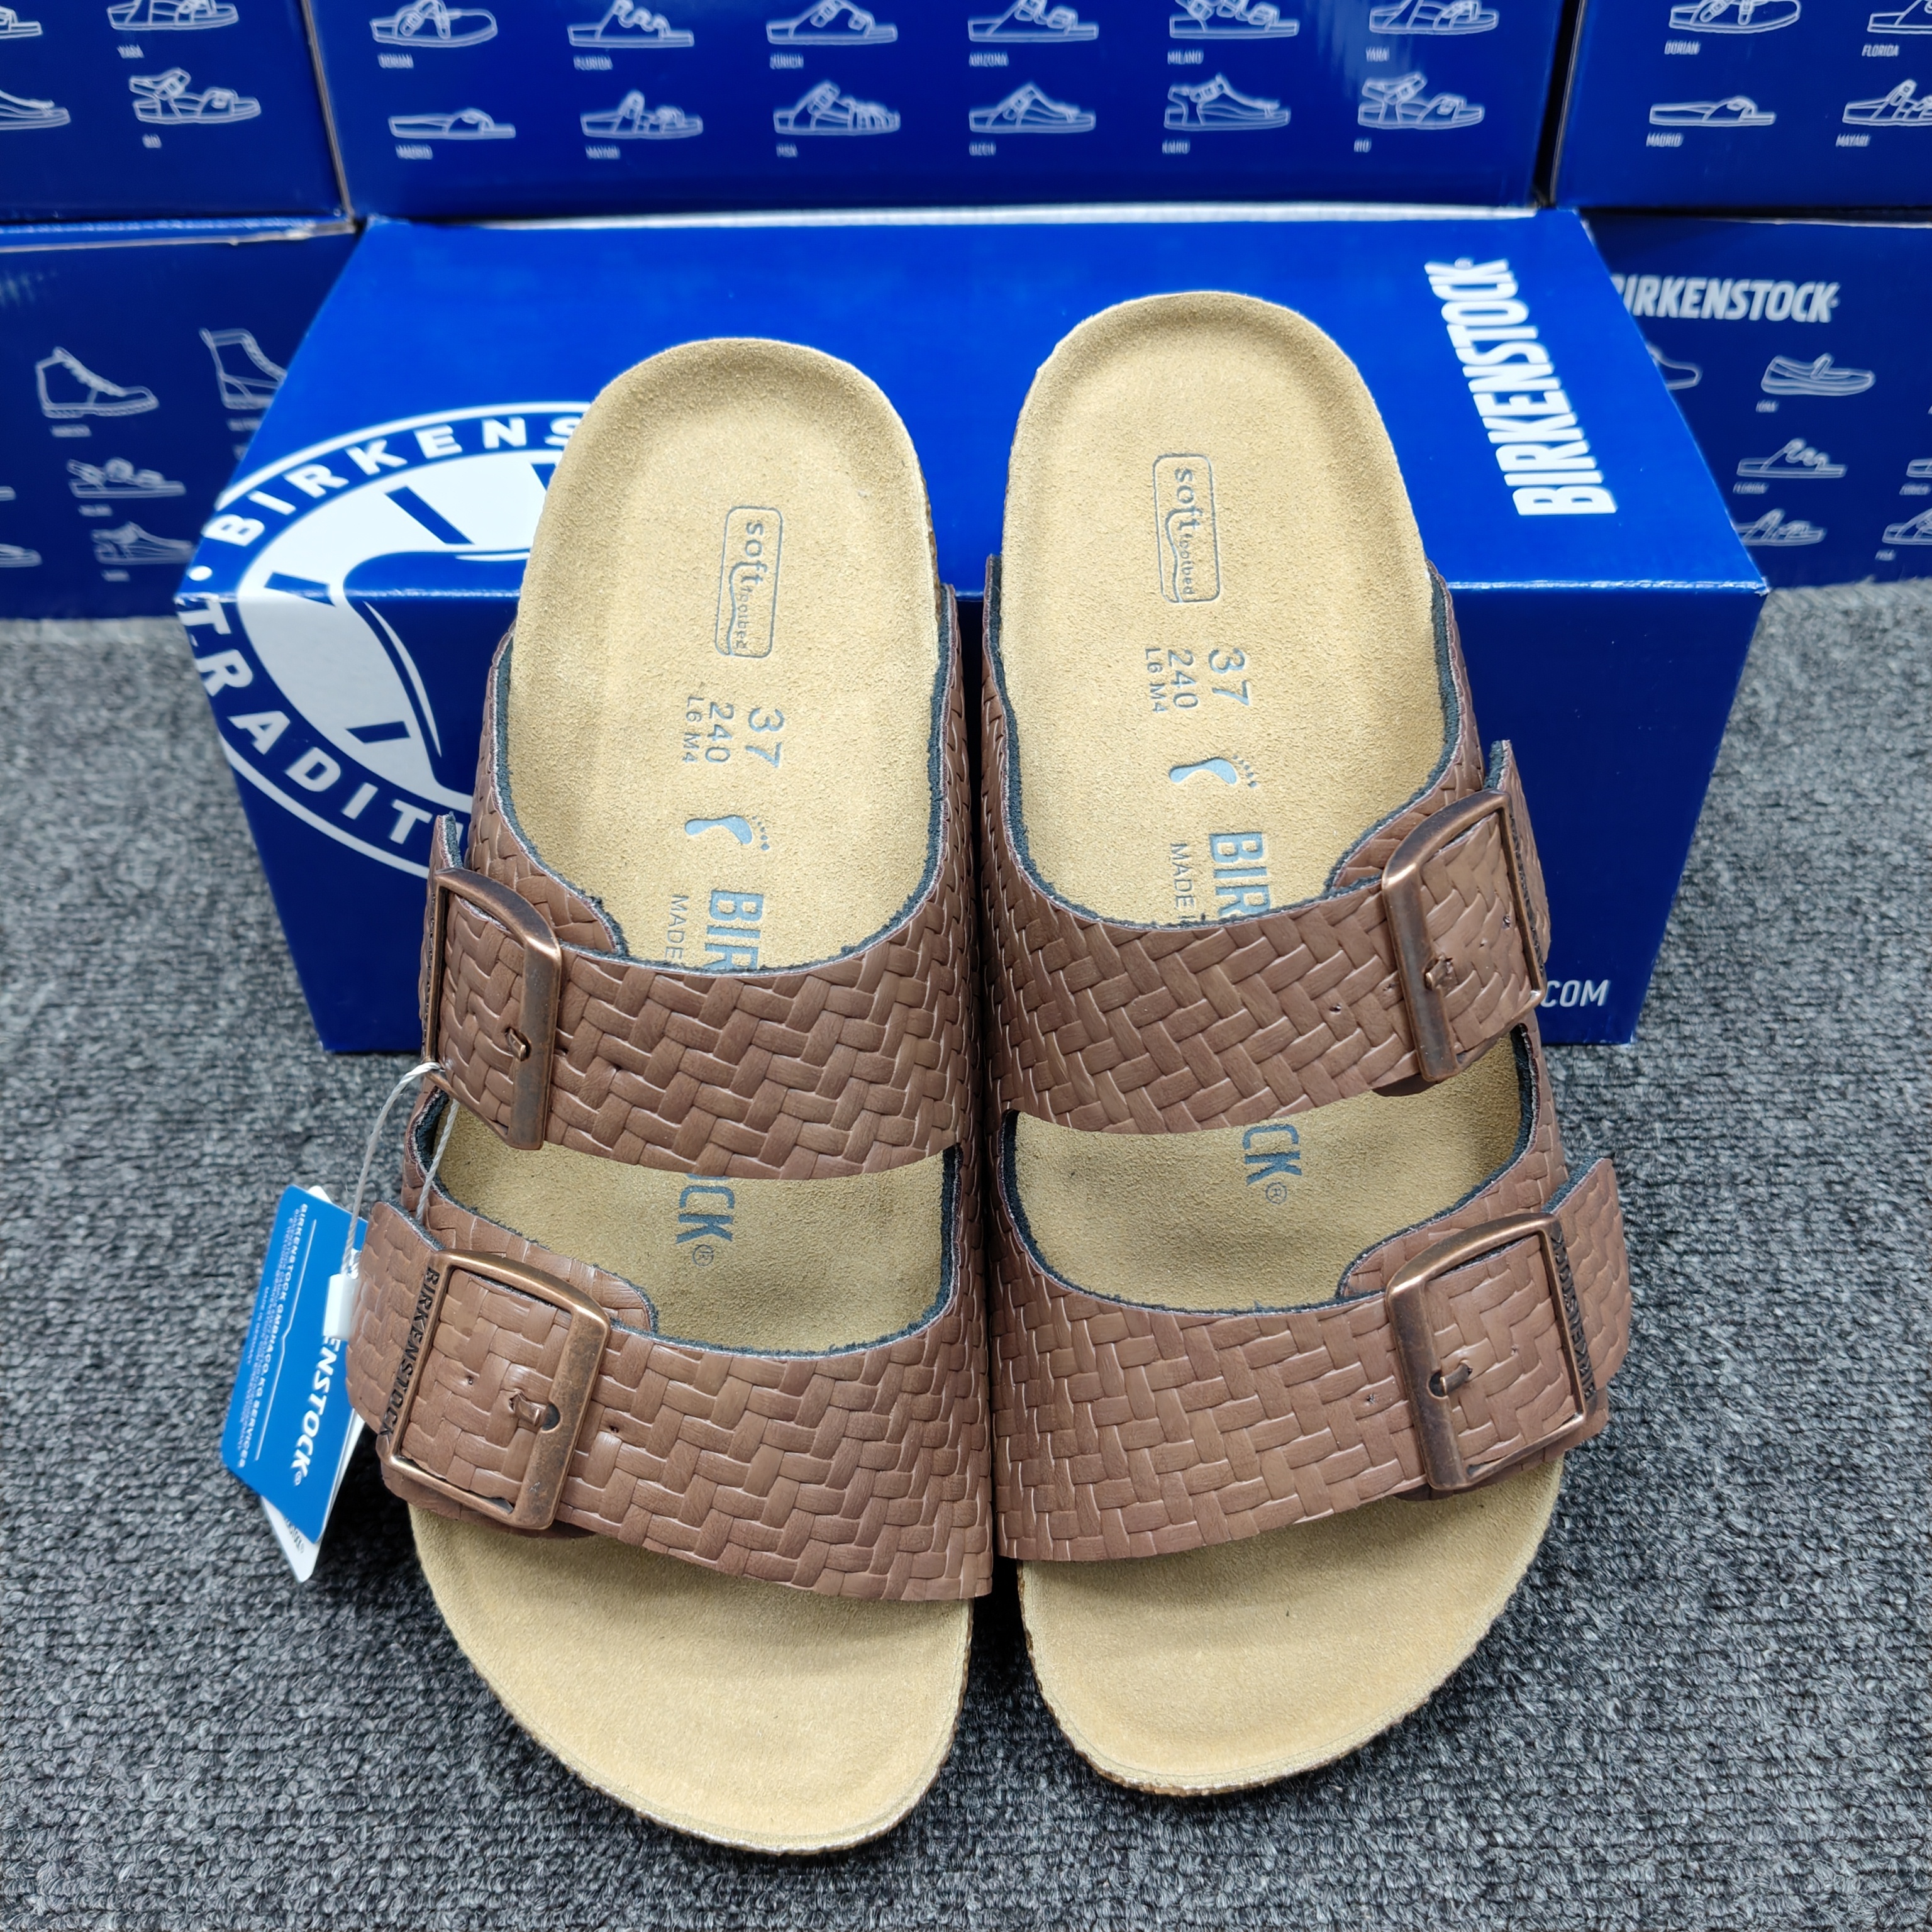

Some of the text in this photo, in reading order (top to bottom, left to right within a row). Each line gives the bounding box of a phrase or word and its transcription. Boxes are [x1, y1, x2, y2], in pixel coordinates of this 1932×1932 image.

[1861, 44, 1899, 57] FLORIDA
[1646, 133, 1684, 147] MADRID
[1424, 258, 1618, 515] BIRKENSTOCK
[1150, 682, 1168, 713] M4
[1168, 648, 1200, 709] 240
[1208, 647, 1251, 707] 37
[177, 597, 464, 845] TRADIT
[682, 732, 700, 763] M4
[704, 701, 735, 763] 240
[746, 708, 785, 768] 37
[1170, 843, 1195, 908] MADE
[665, 893, 689, 960] MADE
[380, 1266, 440, 1445] BIRKENSTOCK
